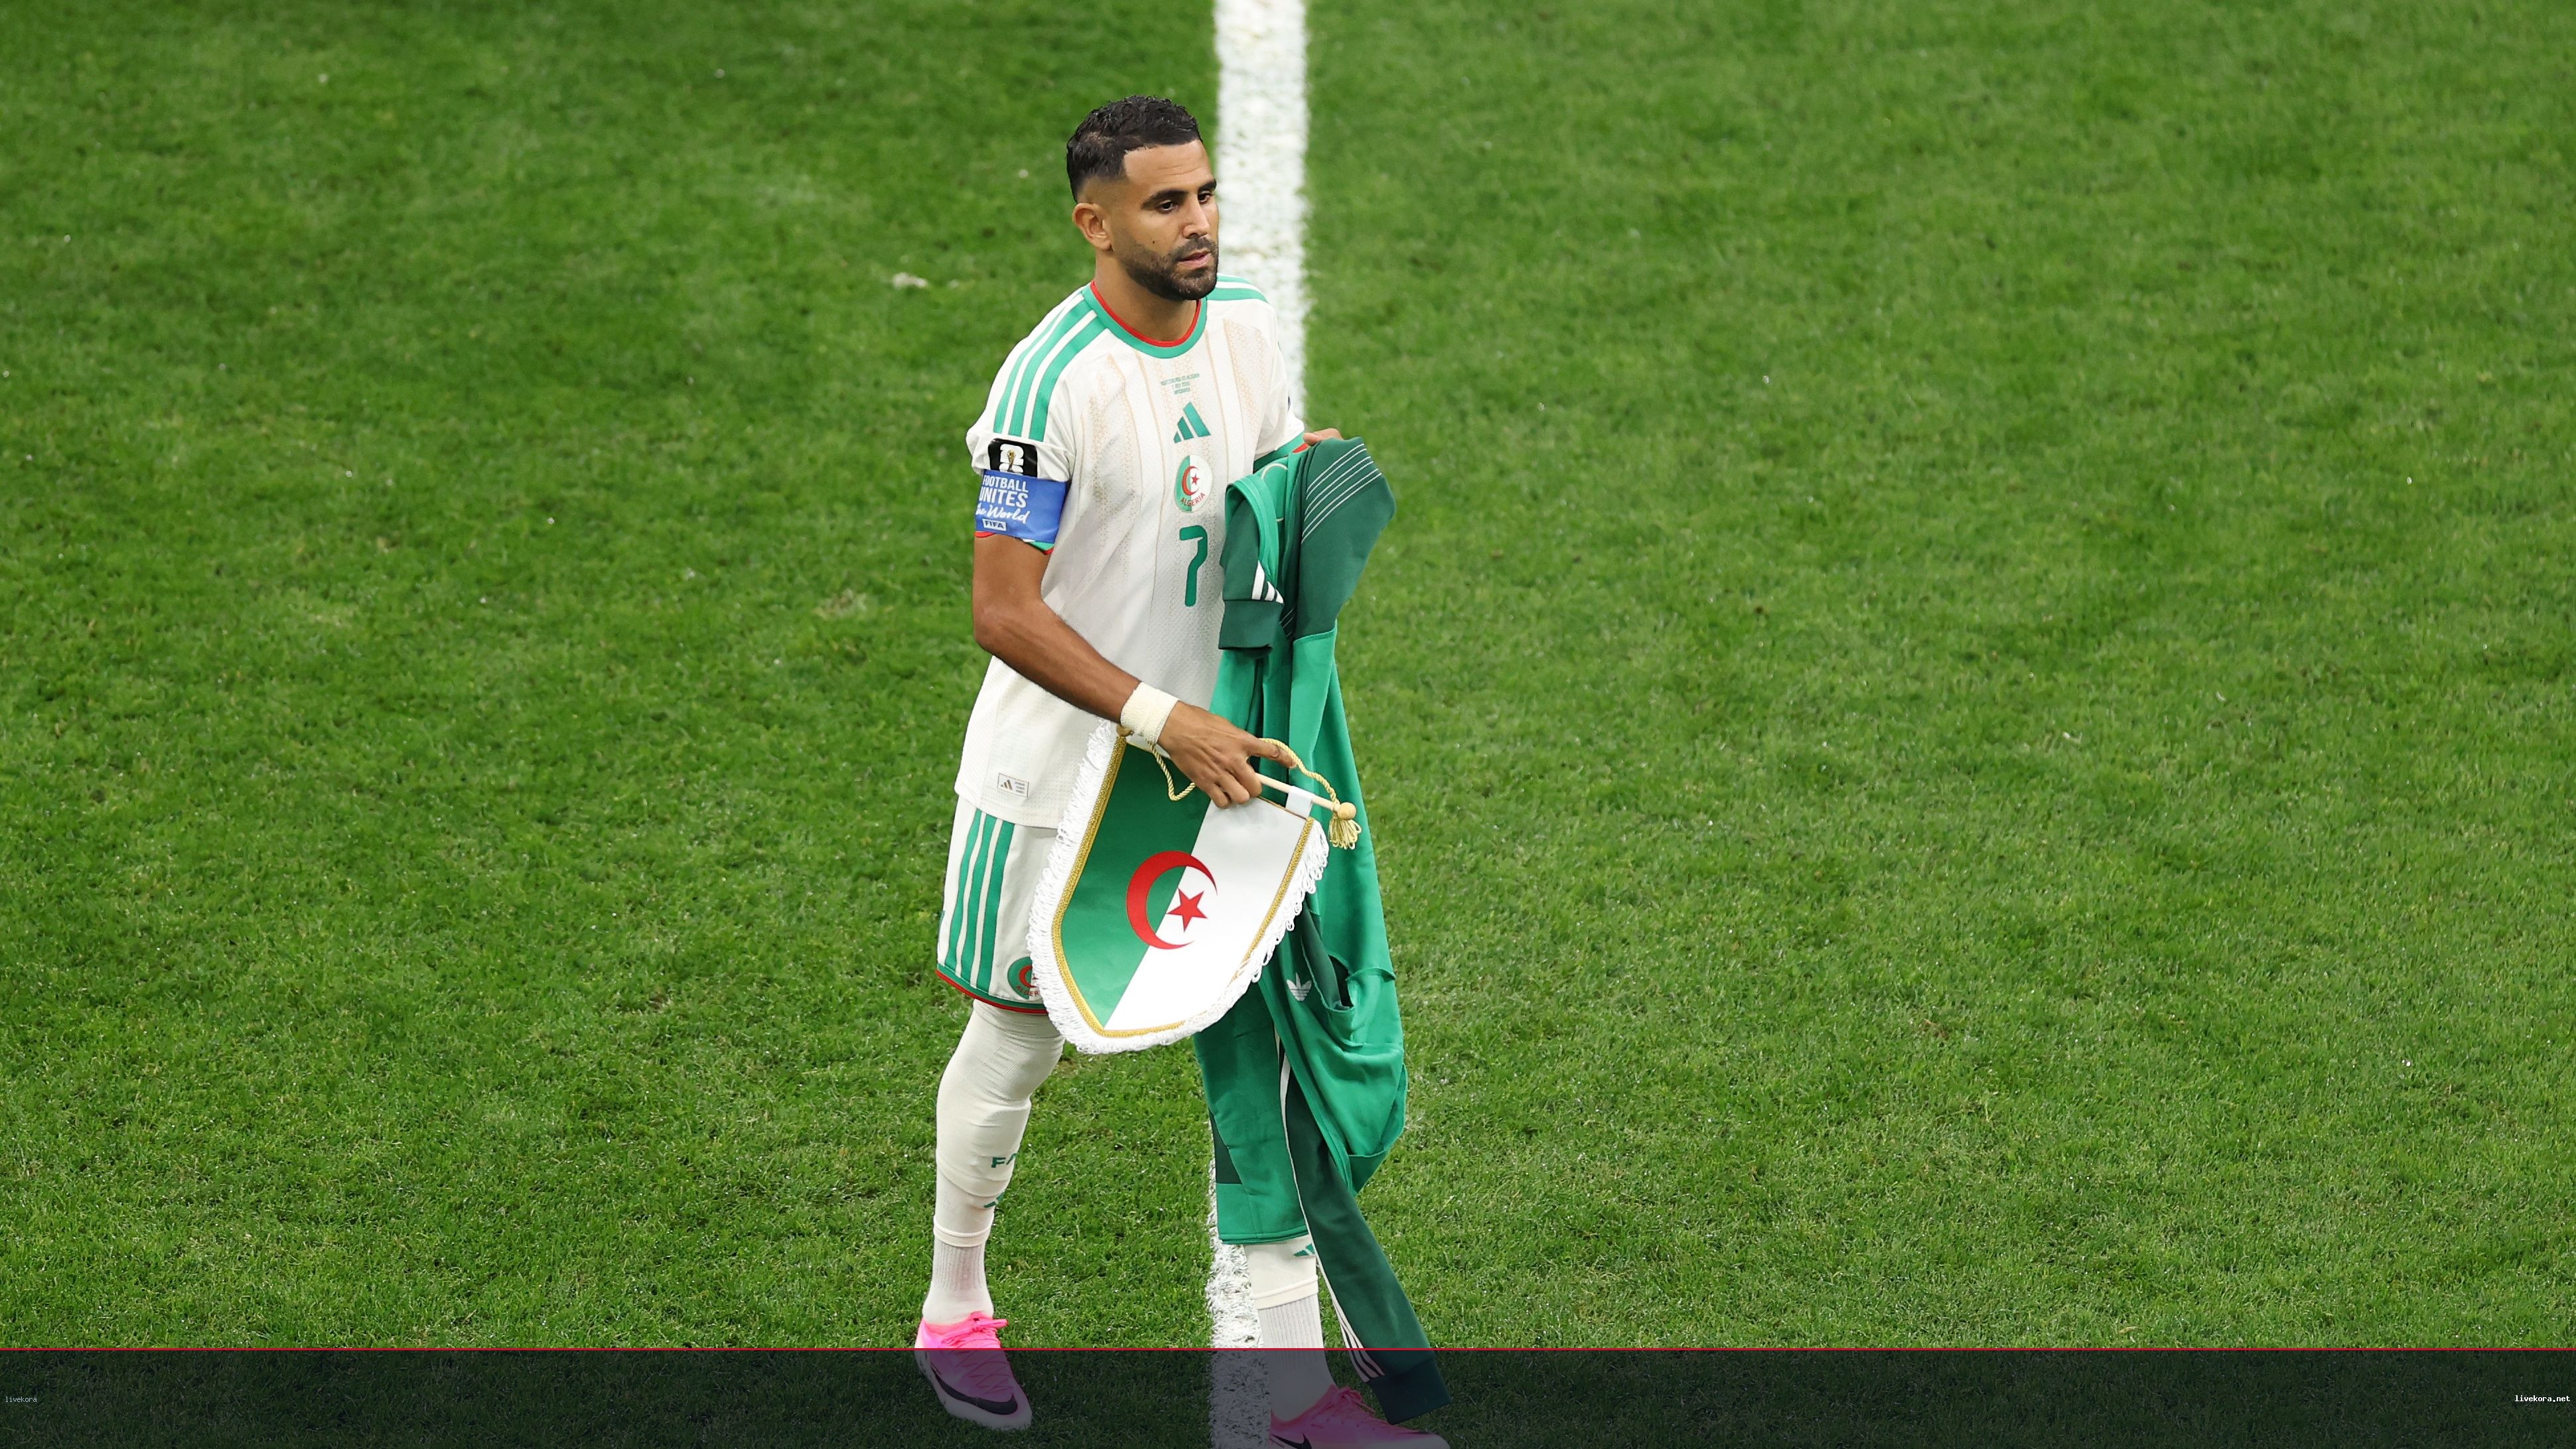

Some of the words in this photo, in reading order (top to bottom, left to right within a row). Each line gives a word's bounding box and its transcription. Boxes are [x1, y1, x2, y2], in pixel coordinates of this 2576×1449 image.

[982, 475, 1029, 493] FOOTBALL
[979, 486, 1029, 508] UNITES
[1181, 492, 1206, 507] ALGERIA
[986, 504, 1031, 524] World
[984, 520, 1004, 529] FIFA
[1179, 525, 1208, 606] 7
